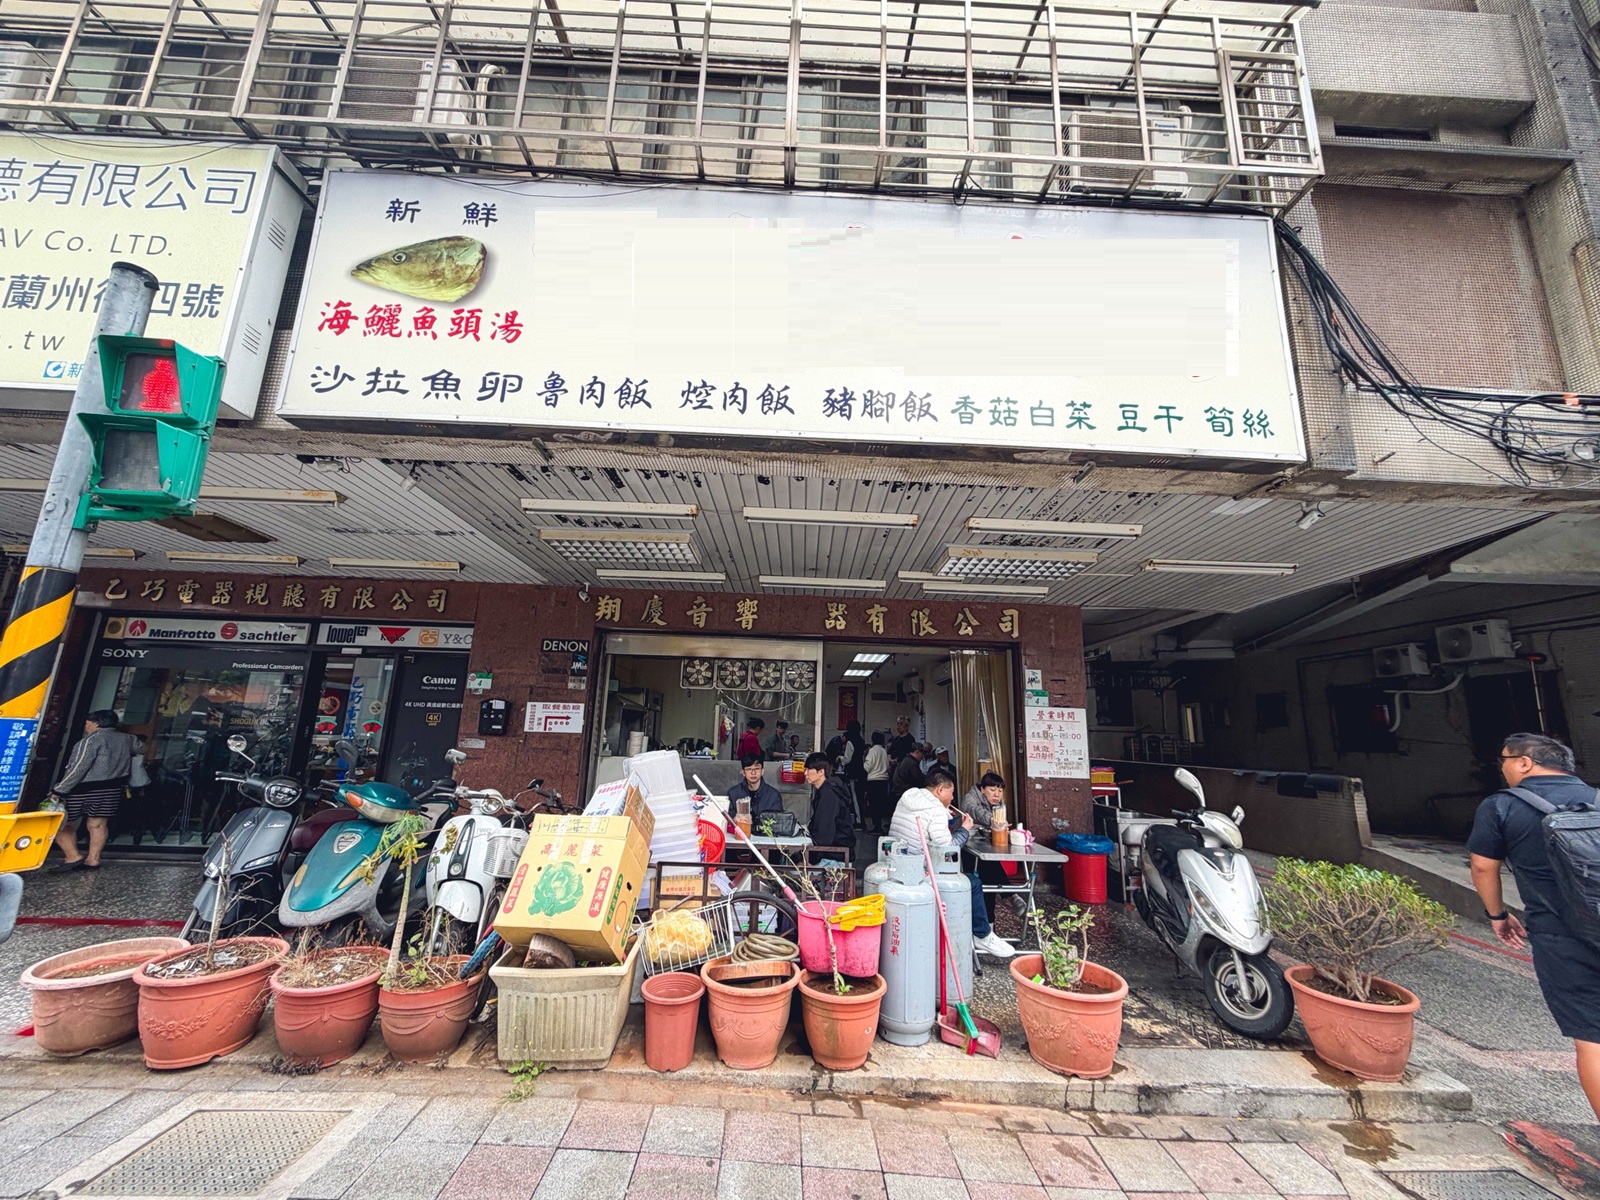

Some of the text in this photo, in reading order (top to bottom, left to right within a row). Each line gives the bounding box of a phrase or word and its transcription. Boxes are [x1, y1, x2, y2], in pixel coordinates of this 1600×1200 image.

[385, 198, 499, 228] 新鮮
[44, 230, 92, 252] Co.
[110, 233, 173, 256] LTD.
[0, 274, 224, 319] 蘭州四號
[317, 299, 524, 344] 海鱺魚頭湯
[310, 364, 524, 403] 沙拉魚卵
[535, 370, 653, 410] 魯肉飯
[821, 386, 939, 424] 豬腳飯
[950, 394, 1097, 432] 香菇白菜
[1116, 403, 1185, 435] 豆干
[1203, 405, 1276, 440] 筍絲
[104, 577, 448, 613] 乙巧電器視聽有限公司
[595, 593, 1021, 640] 翔慶音響 器有限公司
[149, 629, 298, 642] Manfrotto sachtler
[102, 648, 149, 659] SONY
[542, 640, 588, 652] DENON
[232, 662, 268, 670] Professional
[422, 676, 457, 685] Canon
[1037, 710, 1076, 720] 營業時間
[541, 843, 604, 858] 高麗菜
